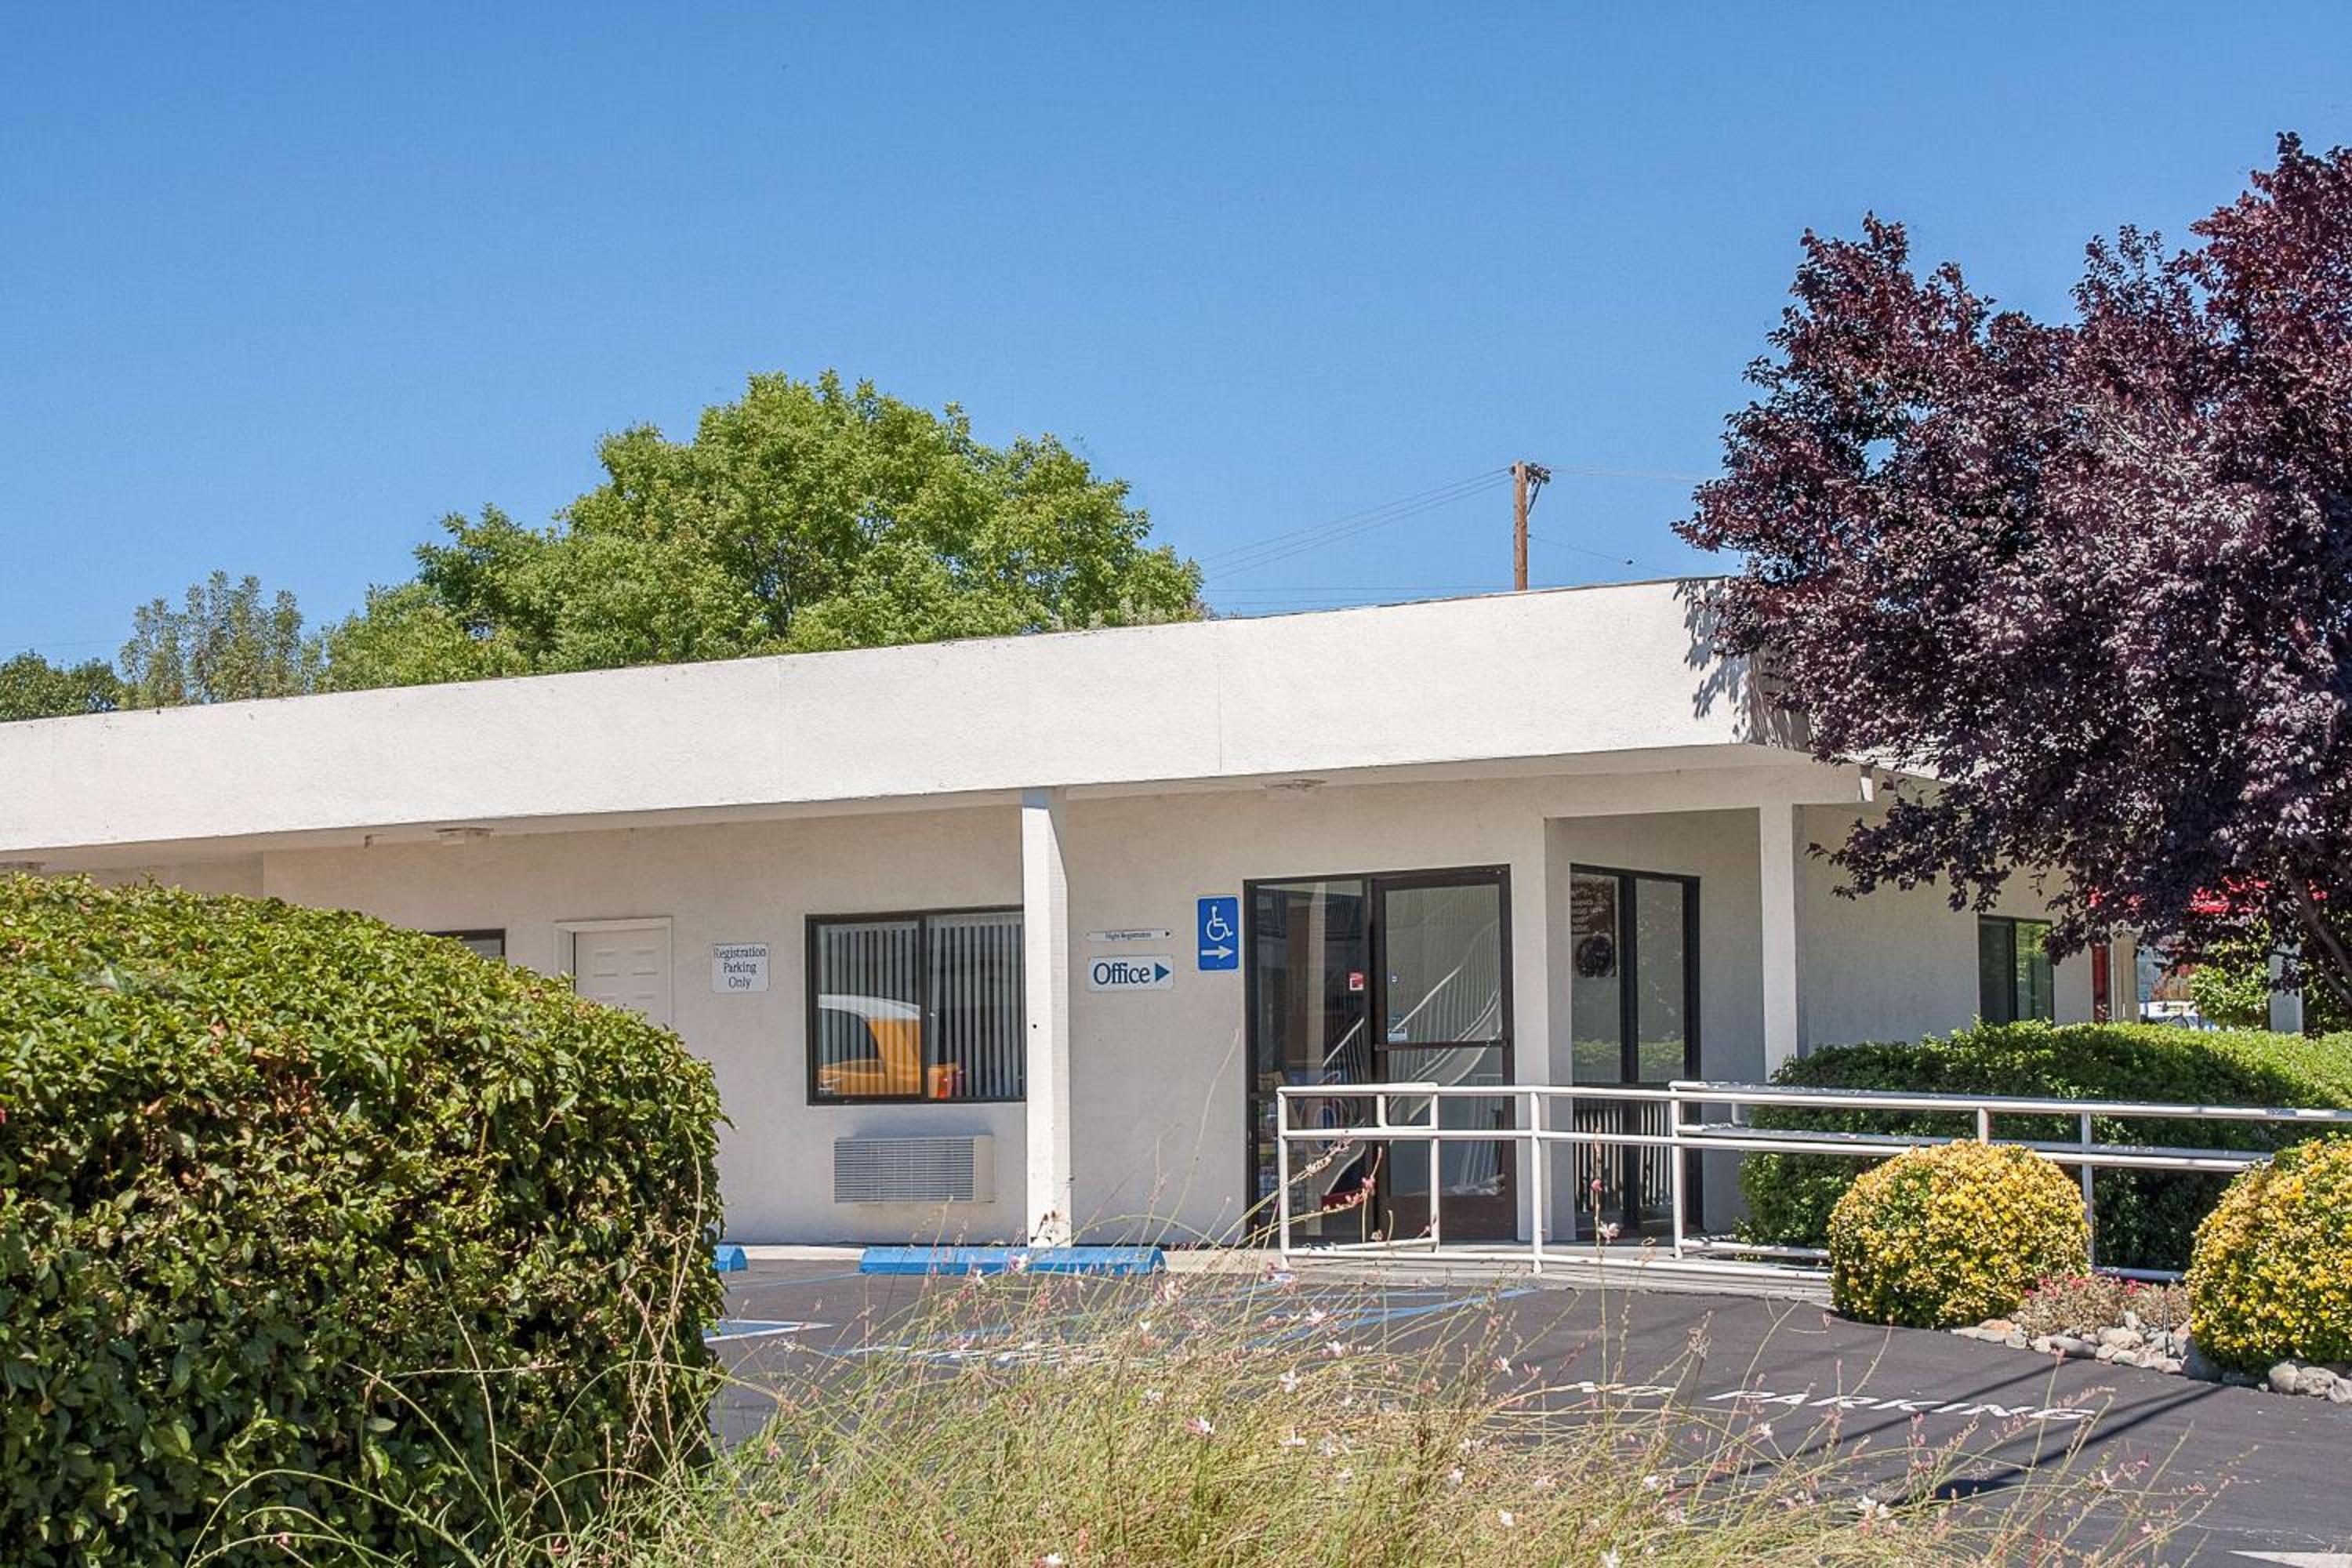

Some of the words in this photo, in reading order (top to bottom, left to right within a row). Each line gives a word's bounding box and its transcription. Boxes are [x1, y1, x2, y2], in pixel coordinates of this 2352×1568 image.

[714, 946, 766, 961] Registration
[724, 961, 757, 975] Parking
[1093, 962, 1151, 985] Office
[728, 976, 752, 989] Only
[1705, 1390, 2096, 1421] PARKING
